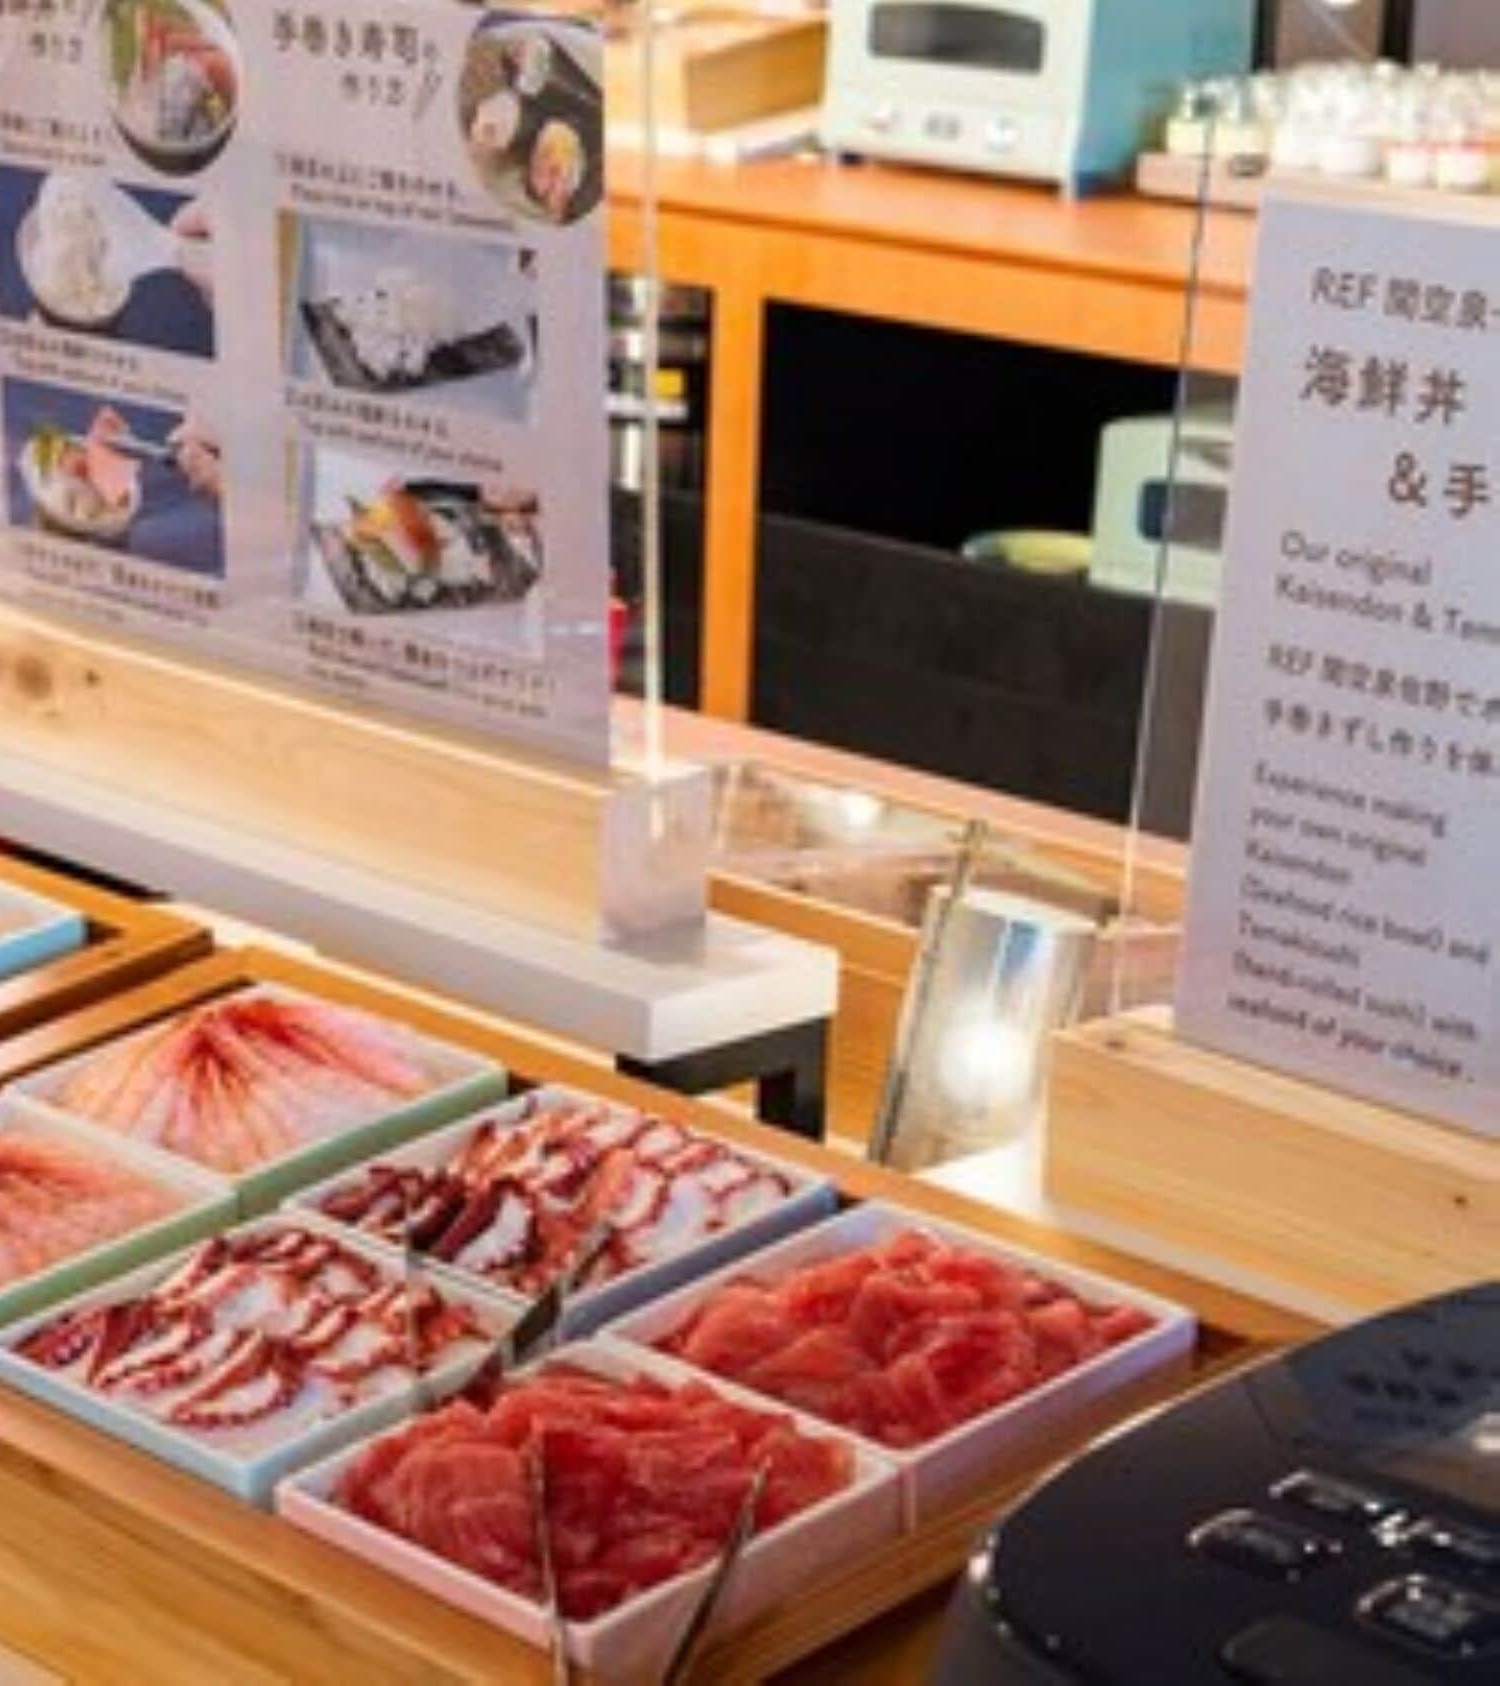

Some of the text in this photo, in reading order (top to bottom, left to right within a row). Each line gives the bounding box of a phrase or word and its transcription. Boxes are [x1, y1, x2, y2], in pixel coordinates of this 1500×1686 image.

[1312, 266, 1500, 332] REF 関空泉
[1300, 343, 1467, 427] 海鮮丼
[1389, 451, 1491, 519] & 手
[1281, 530, 1432, 587] Our original
[1275, 572, 1403, 623] Kaisendon
[1411, 600, 1432, 633] &
[1254, 759, 1446, 839] Experience making
[1300, 819, 1343, 841] own
[1347, 832, 1428, 867] original
